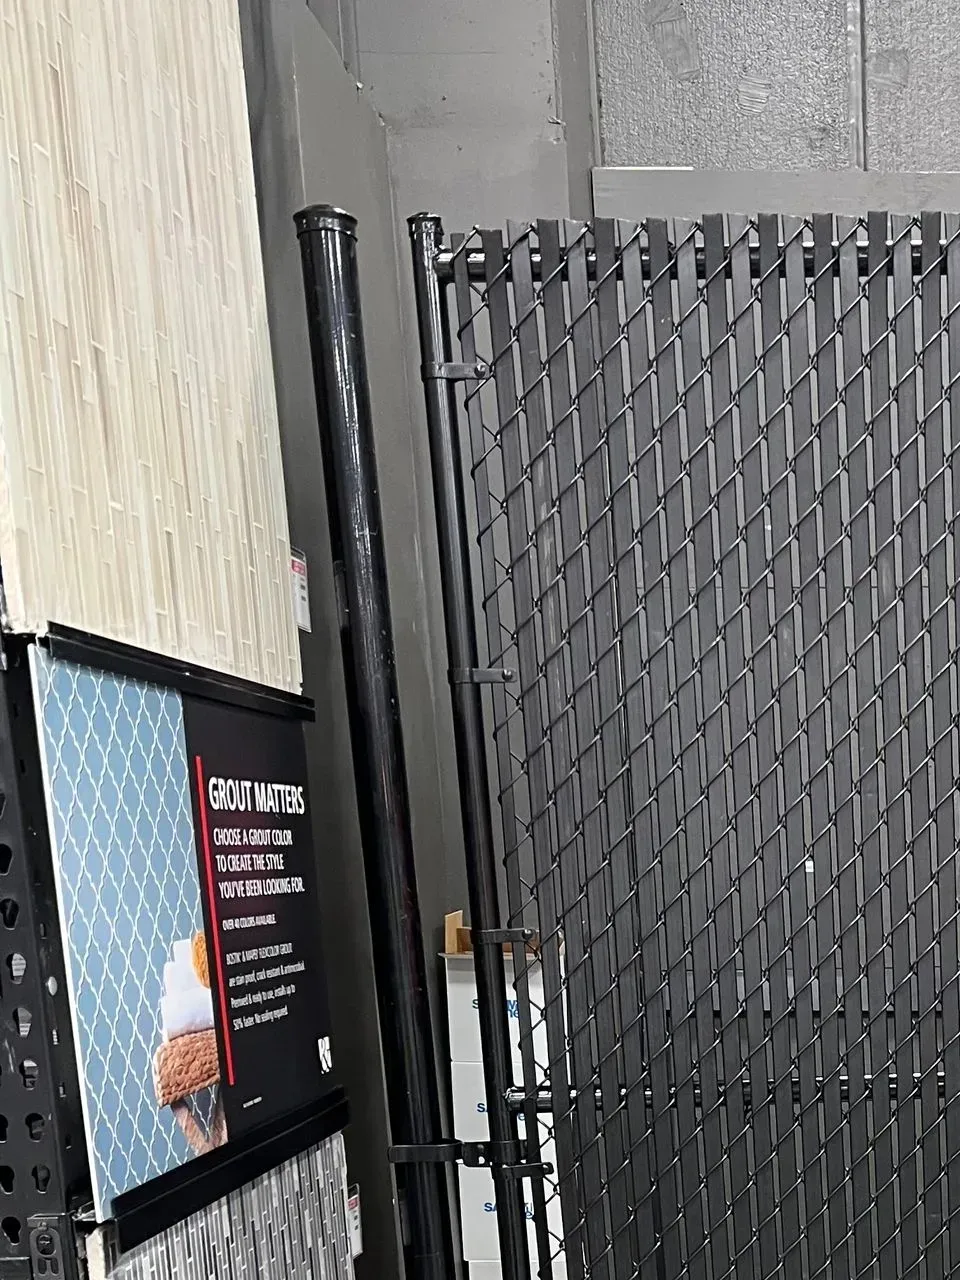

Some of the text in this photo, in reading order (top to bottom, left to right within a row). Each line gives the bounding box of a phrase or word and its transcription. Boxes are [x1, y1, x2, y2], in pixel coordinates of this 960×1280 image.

[208, 776, 305, 815] GROUT MATTERS
[213, 827, 293, 846] CHOOSE A GROUT COLOR
[215, 853, 285, 873] TO CREATE THE STYLE
[218, 876, 305, 899] YOU'VE BEEN LOOKING FOR.
